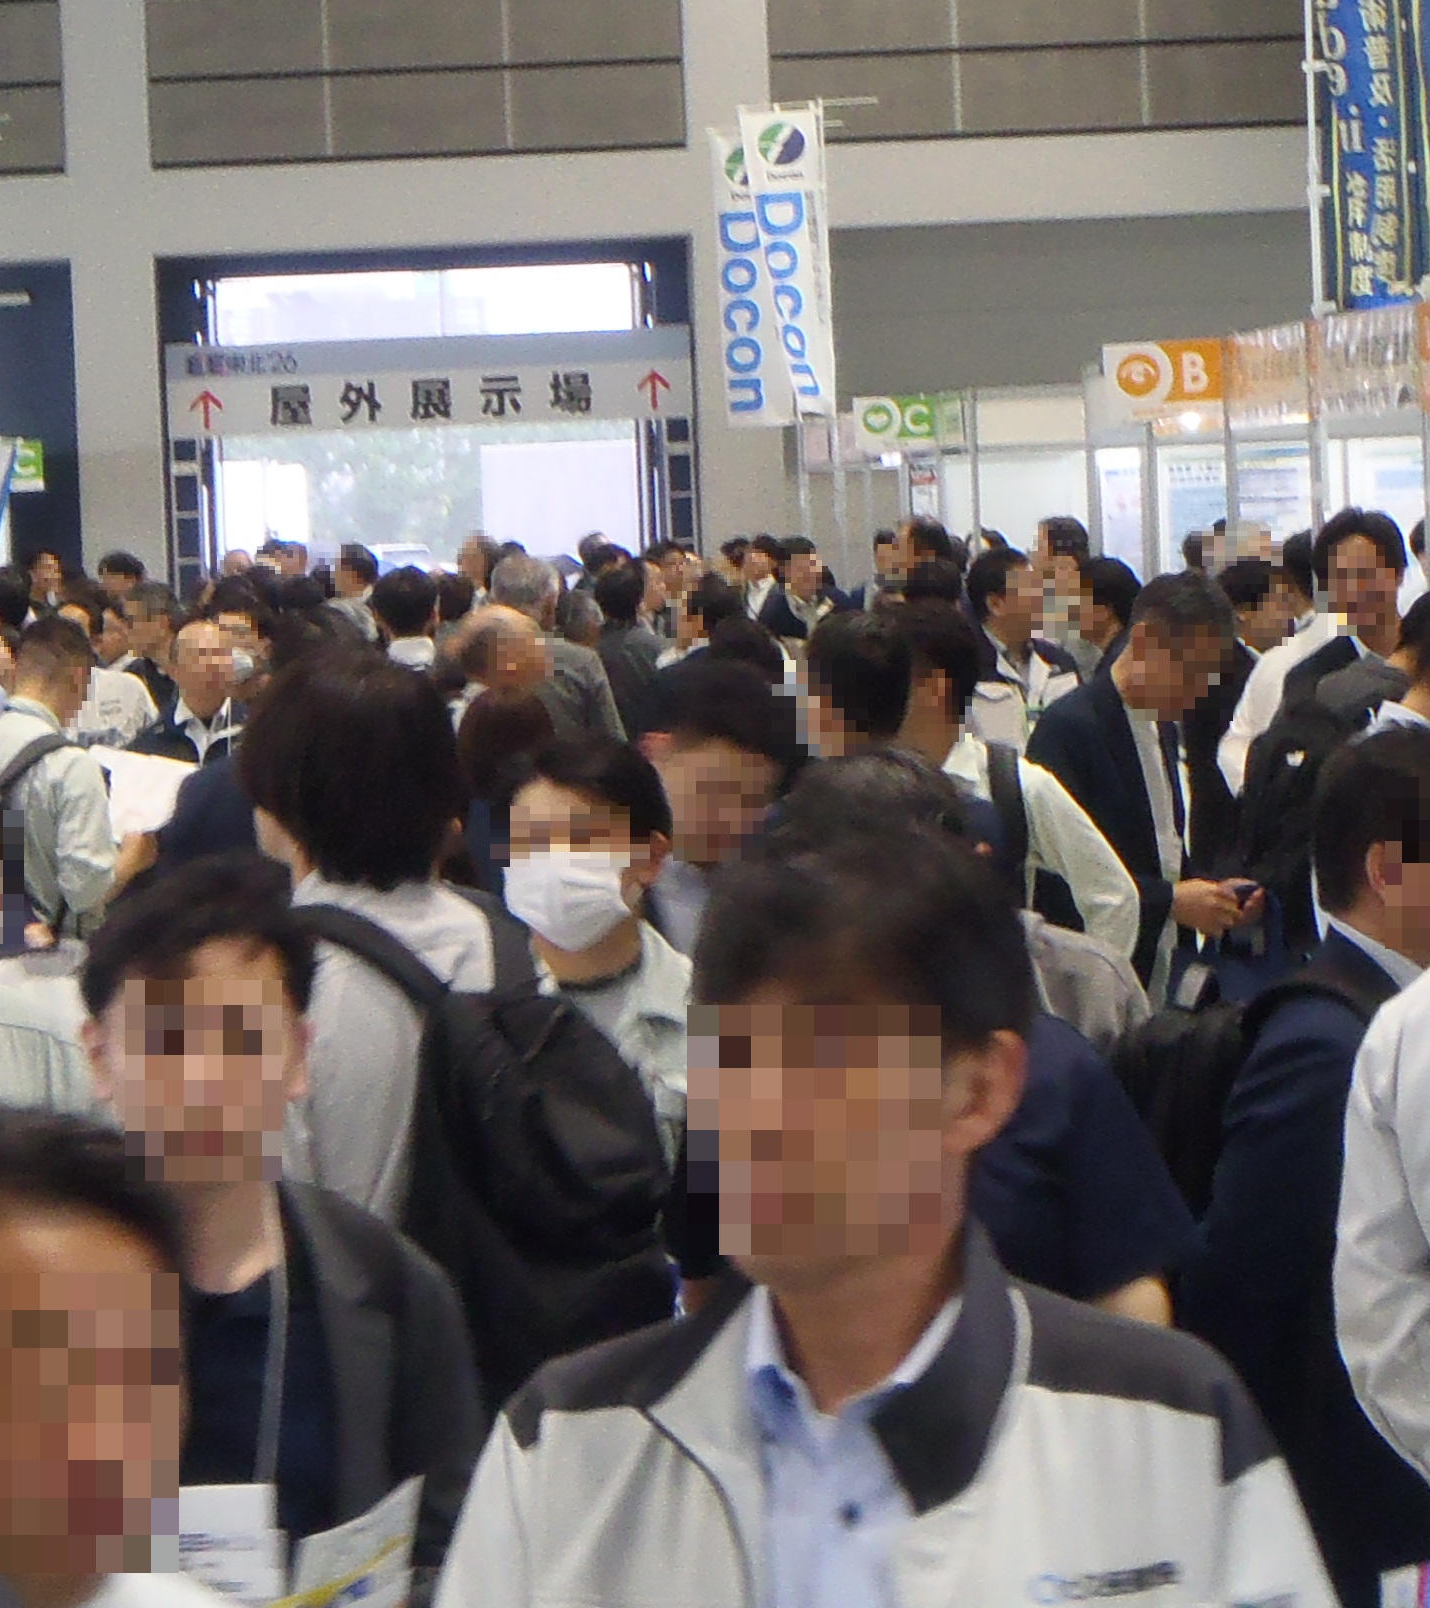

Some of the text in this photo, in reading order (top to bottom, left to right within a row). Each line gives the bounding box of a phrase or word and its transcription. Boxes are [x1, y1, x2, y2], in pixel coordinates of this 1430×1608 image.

[720, 211, 764, 412] Docon
[756, 191, 821, 397] Docon
[270, 370, 593, 426] 屋外展示場
[1182, 351, 1210, 394] B
[904, 403, 930, 434] C
